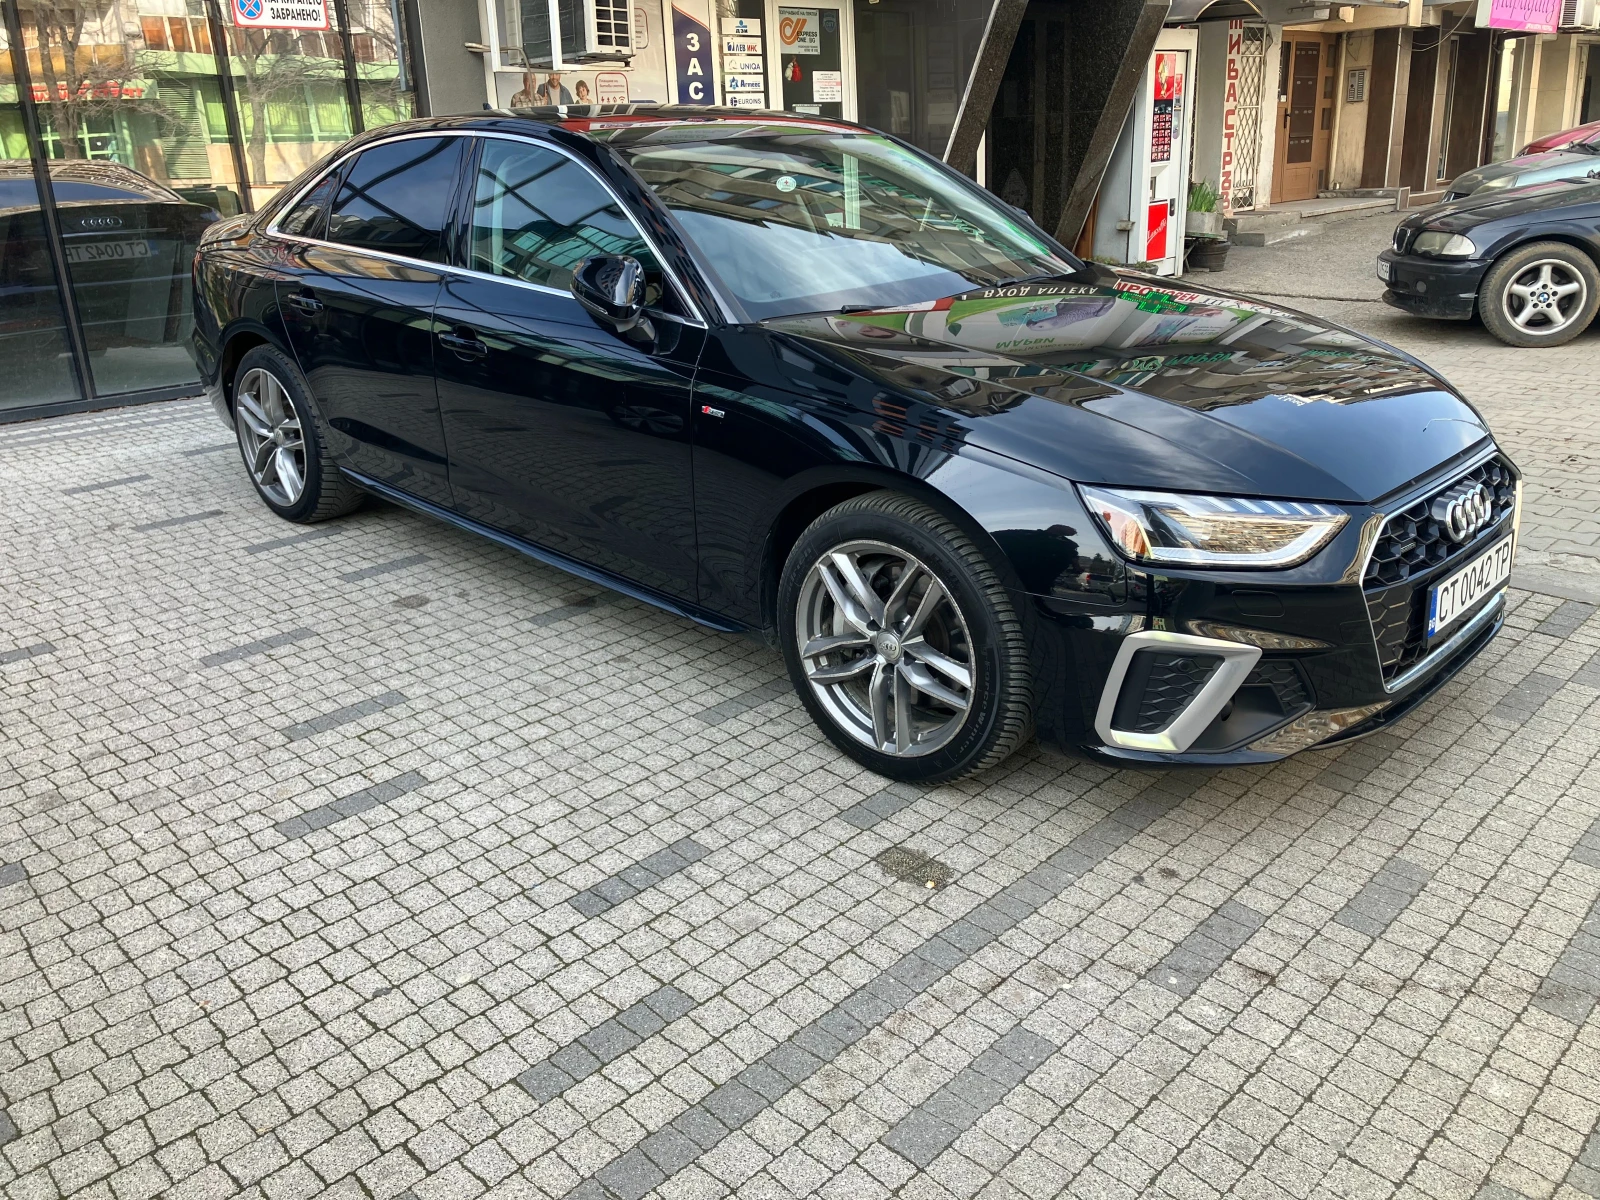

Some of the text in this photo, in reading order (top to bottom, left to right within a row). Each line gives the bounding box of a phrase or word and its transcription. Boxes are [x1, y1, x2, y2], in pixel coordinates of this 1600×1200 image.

[270, 8, 321, 21] ЗАБРАНЕНО!
[1439, 541, 1509, 622] CT 0042 TP
